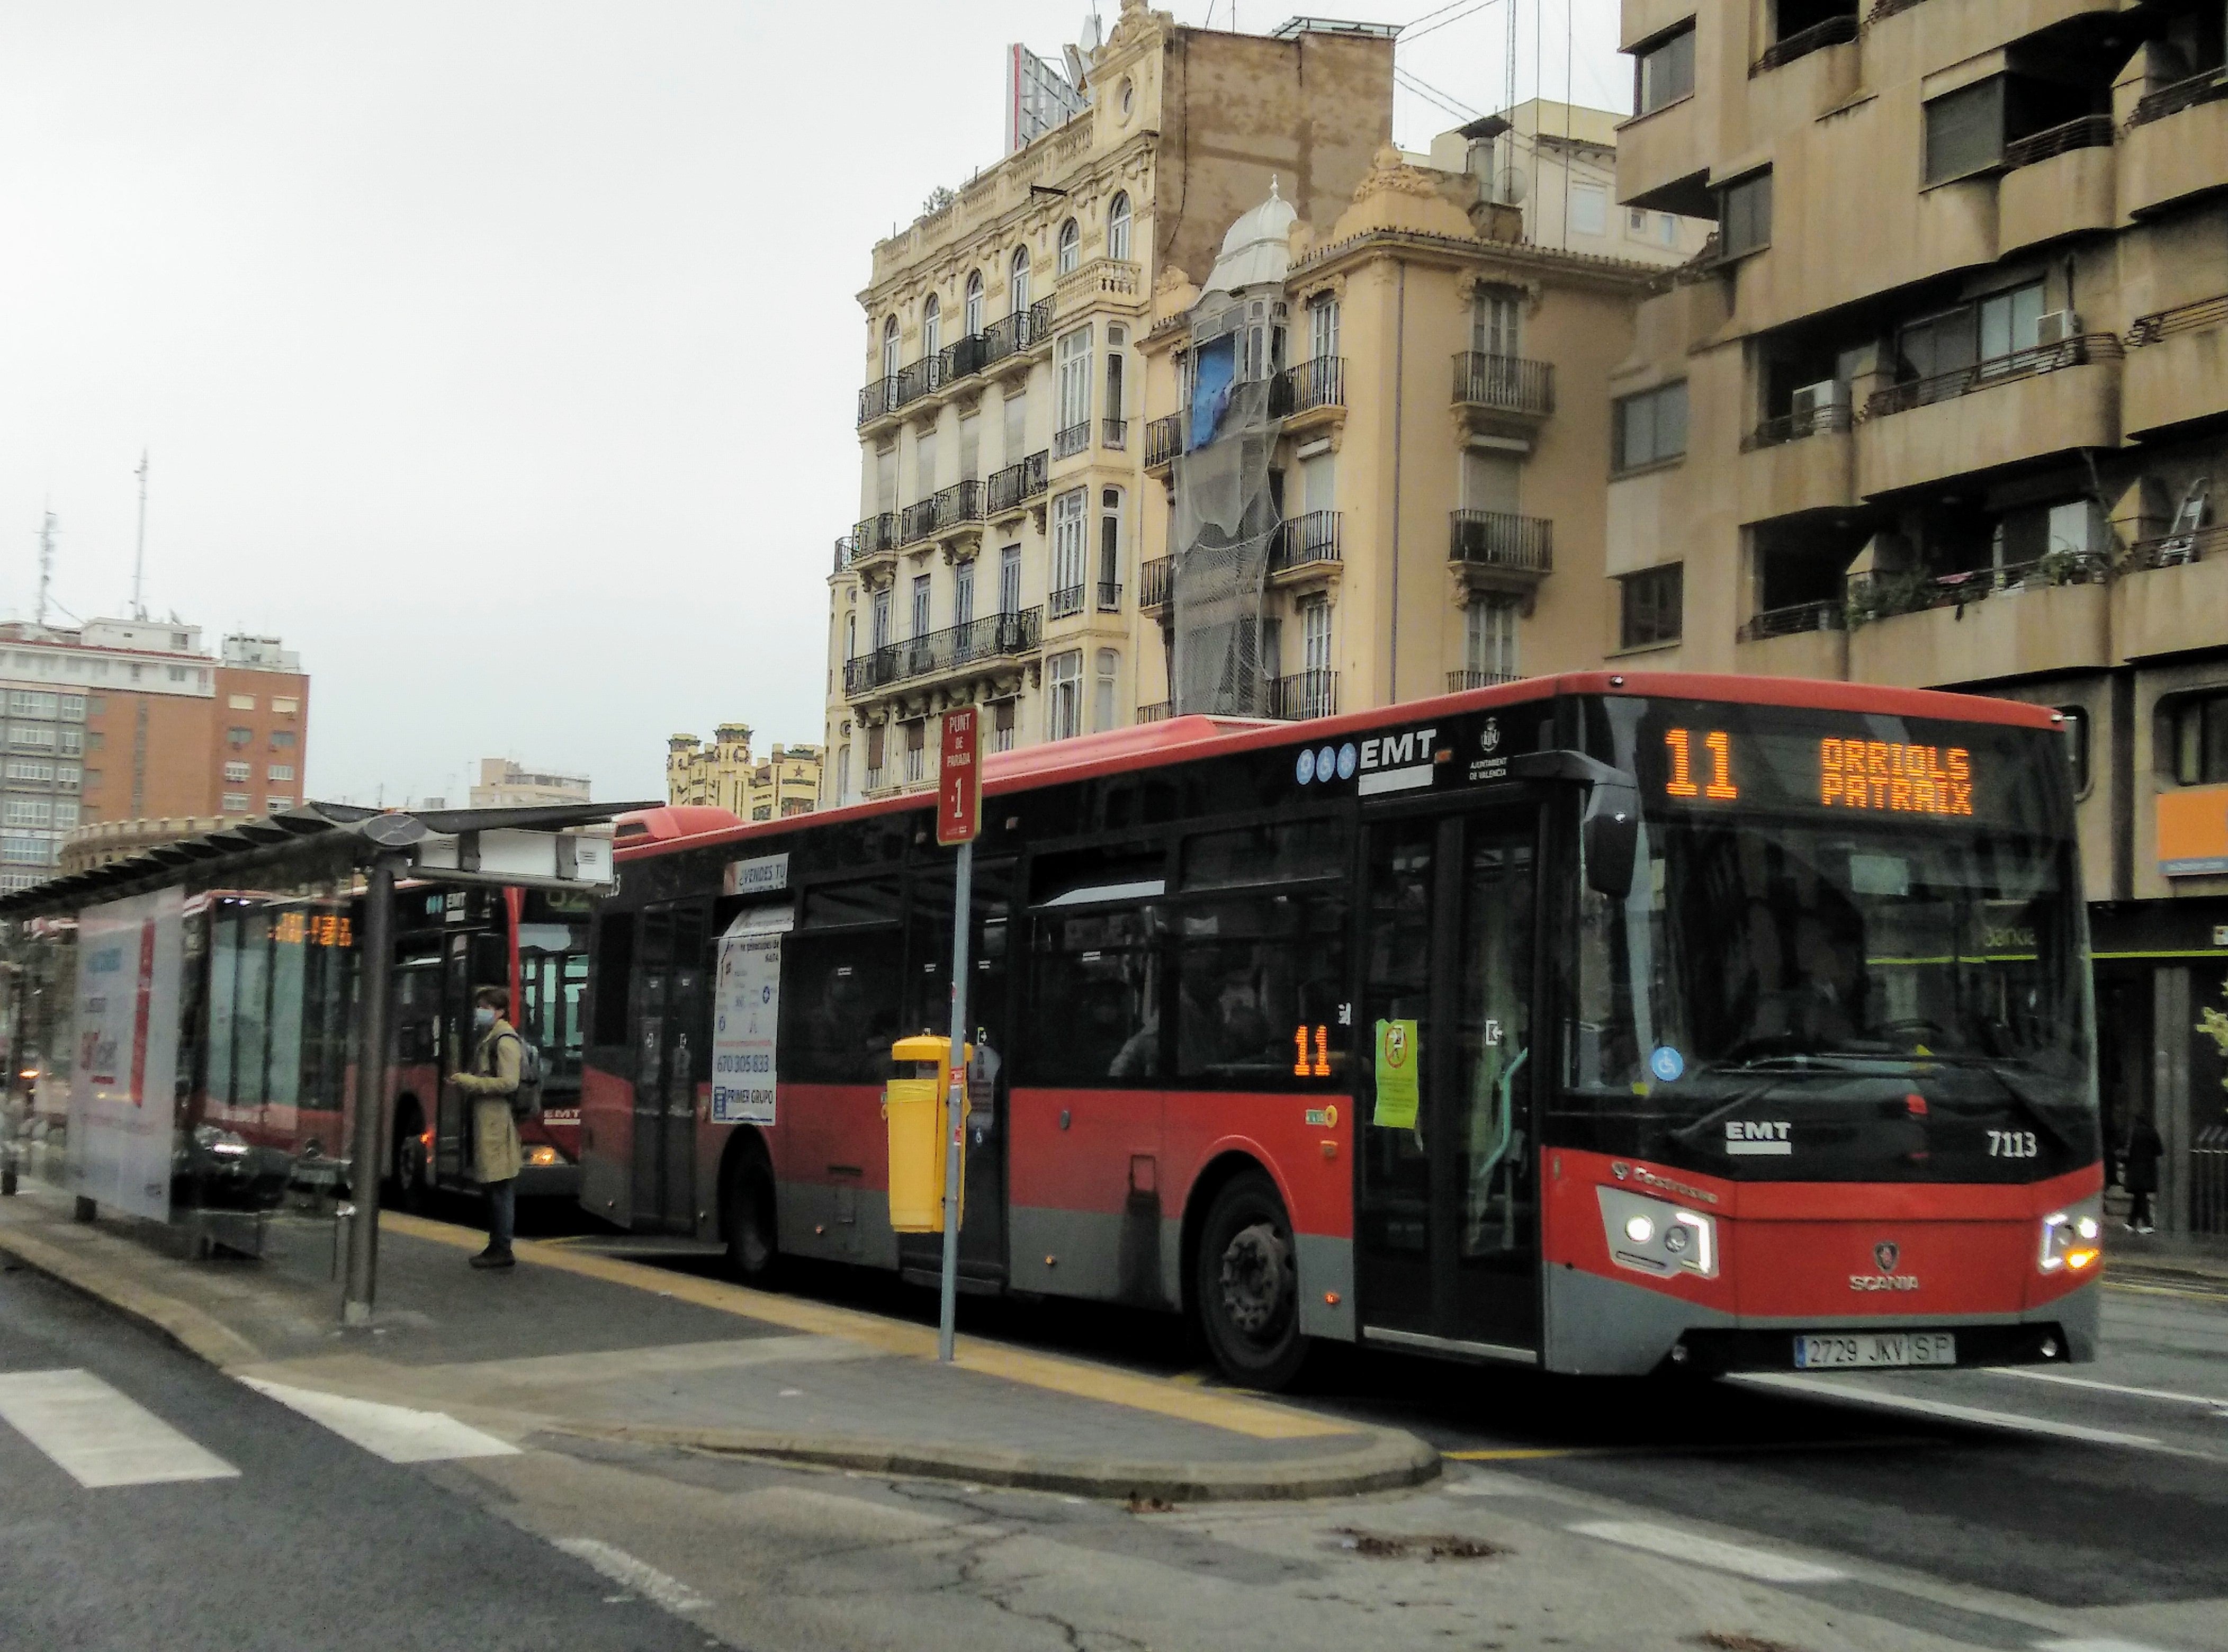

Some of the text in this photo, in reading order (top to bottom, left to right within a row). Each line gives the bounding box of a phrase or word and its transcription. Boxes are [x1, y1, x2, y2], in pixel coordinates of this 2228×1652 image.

[949, 713, 971, 734] PUNT
[1360, 729, 1436, 769] EMT
[1665, 729, 1738, 799] 11
[1822, 738, 1970, 780] ORRIOLS
[954, 778, 963, 818] 1
[1822, 773, 1973, 816] PATRAIX
[1294, 1025, 1331, 1076] 11
[544, 1109, 581, 1118] EMT
[1726, 1121, 1791, 1140] EMT
[1987, 1130, 2037, 1158] 7113
[1849, 1274, 1919, 1291] SCANIA
[1810, 1339, 1856, 1362] 2729
[1915, 1337, 1950, 1360] SP
